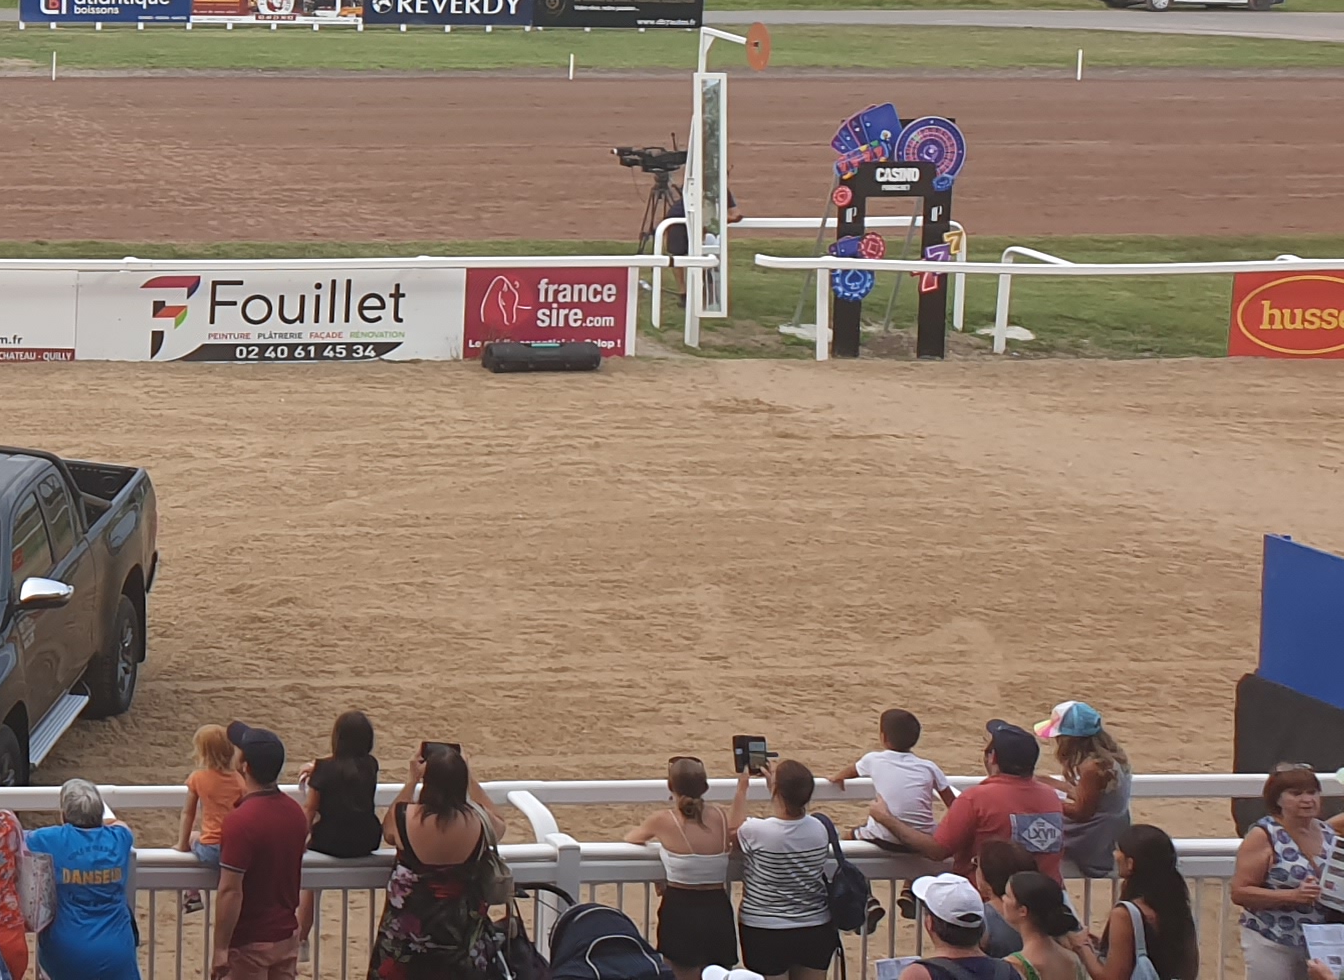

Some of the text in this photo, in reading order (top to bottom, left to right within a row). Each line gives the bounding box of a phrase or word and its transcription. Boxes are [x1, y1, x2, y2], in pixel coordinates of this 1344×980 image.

[74, 4, 120, 15] boissons
[875, 167, 920, 183] CASINO
[537, 278, 617, 303] france
[209, 278, 406, 325] Fouillet
[536, 303, 615, 327] sire.com
[208, 329, 405, 340] PEINTURE PLÂTRERIE FAÇADE RÉNOVATION
[468, 339, 482, 348] Le
[235, 345, 377, 359] 02 40 61 45 34
